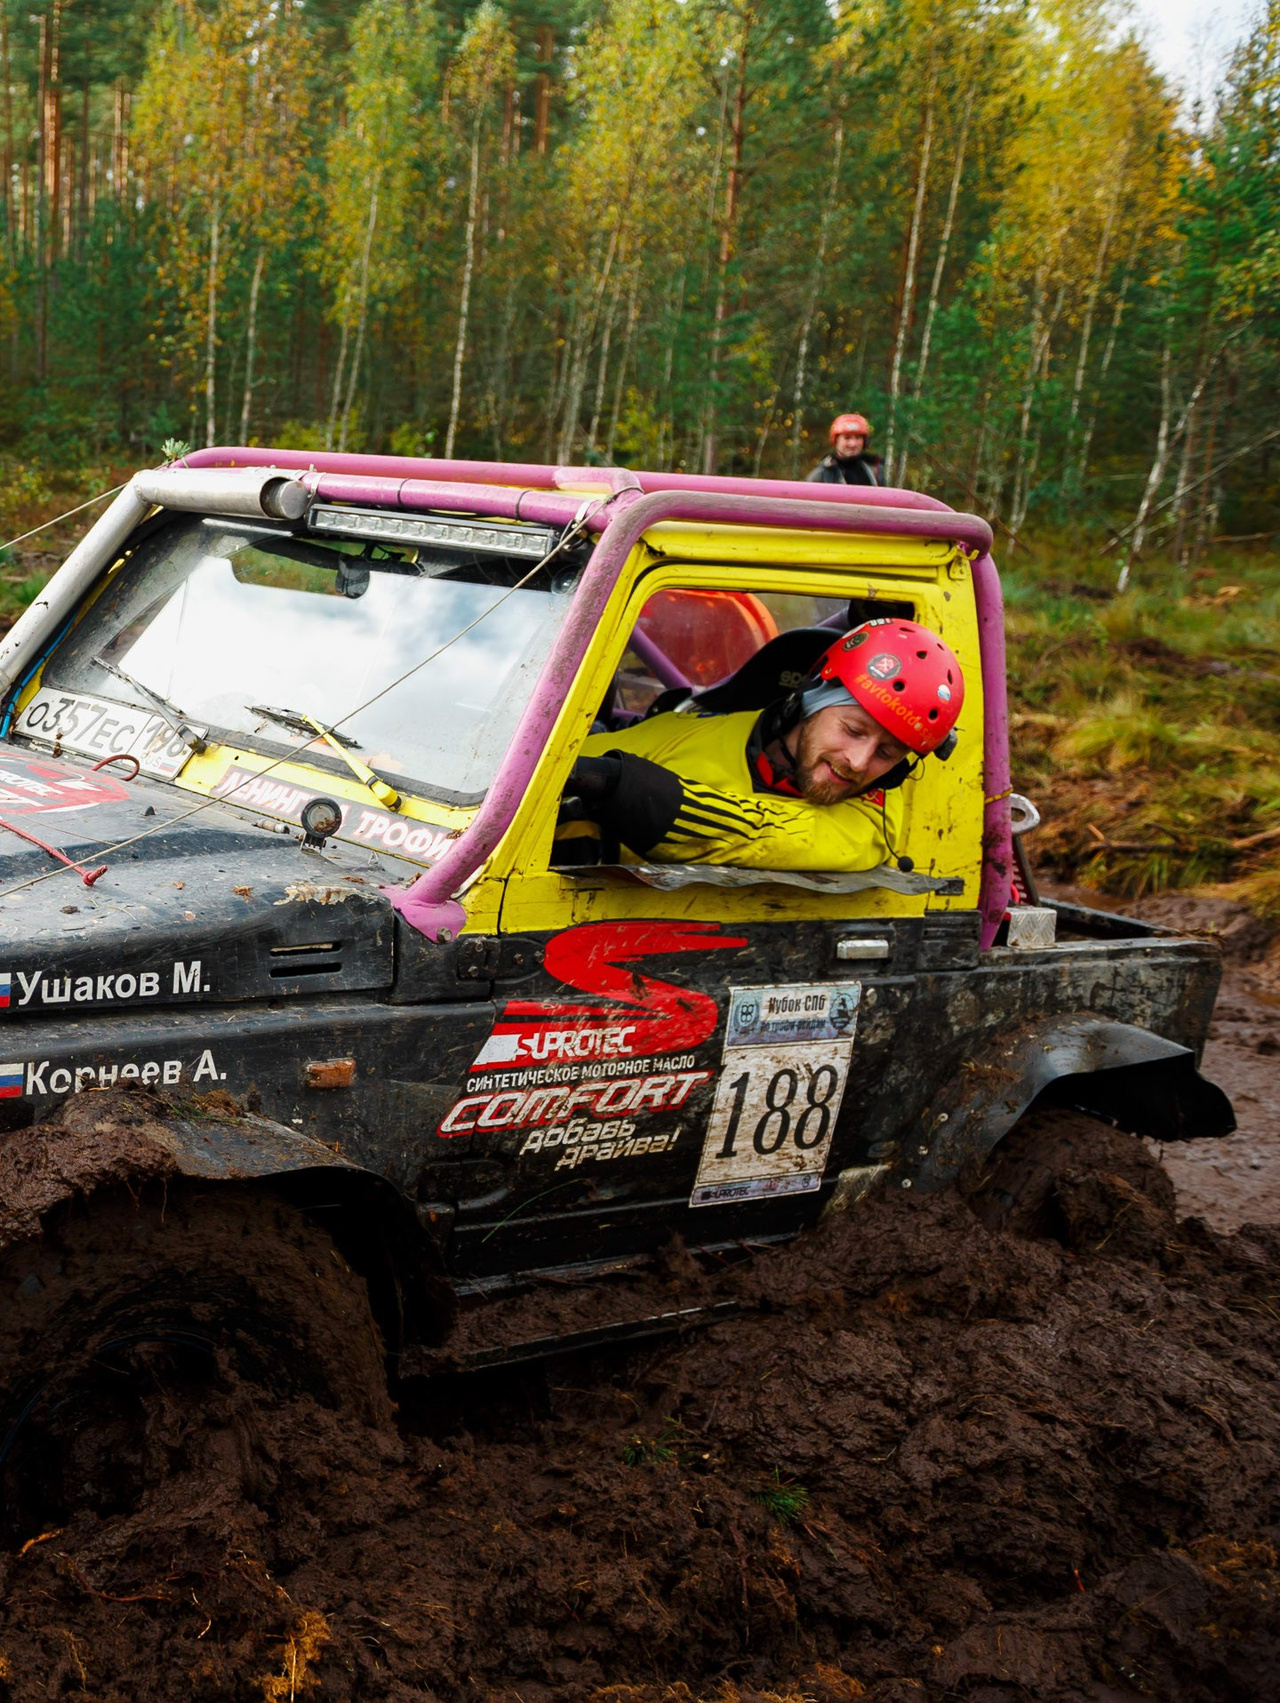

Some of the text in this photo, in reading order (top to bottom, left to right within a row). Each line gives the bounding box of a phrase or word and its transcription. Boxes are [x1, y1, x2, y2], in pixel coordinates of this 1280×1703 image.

[355, 810, 456, 862] ТРОФИ
[16, 960, 211, 1005] Ушаков М.
[767, 994, 826, 1015] Кубок СПб
[510, 1026, 636, 1062] SUPROTEC
[193, 1049, 227, 1082] А.
[467, 1054, 695, 1093] СИНТЕТИЧЕСКОЕ МОТОРНОЕ МАСЛО
[438, 1071, 710, 1136] COMFORT
[715, 1064, 838, 1160] 188
